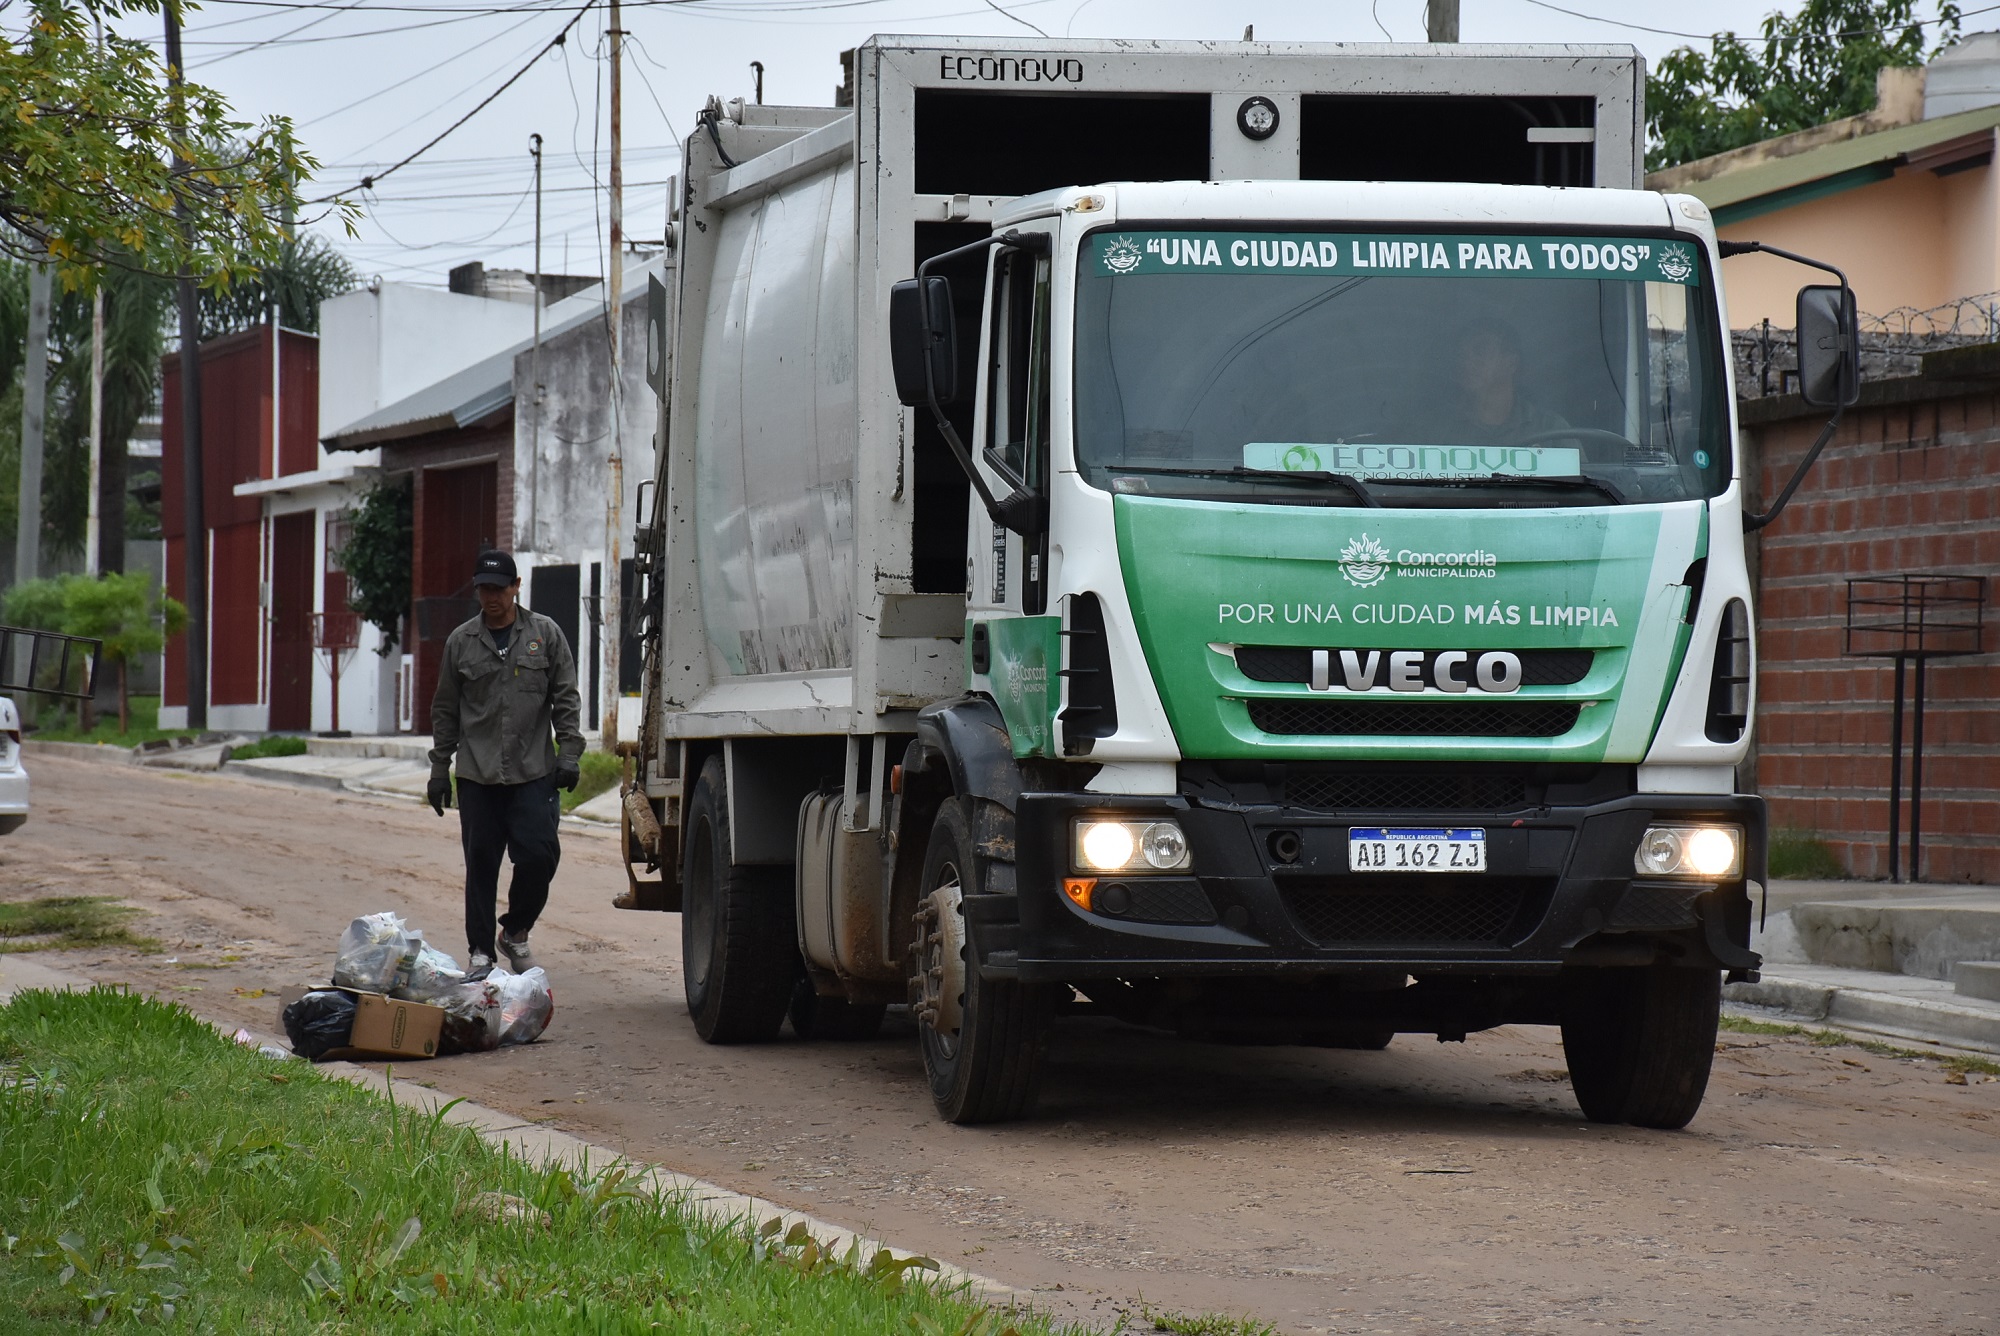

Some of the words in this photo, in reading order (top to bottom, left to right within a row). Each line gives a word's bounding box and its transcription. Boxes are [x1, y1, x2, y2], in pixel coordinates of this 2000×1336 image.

[1230, 240, 1338, 268] CIUDAD
[1352, 241, 1450, 269] LIMPIA
[1457, 243, 1533, 270] PARA
[1397, 549, 1497, 567] Concordia
[1397, 568, 1496, 578] MUNICIPALIDAD
[1218, 603, 1274, 624] POR
[1284, 604, 1342, 624] UNA
[1352, 604, 1455, 625] CIUDAD
[1464, 600, 1521, 626] MÁS
[1530, 606, 1619, 628] LIMPIA
[1311, 650, 1523, 693] IVECO
[1357, 843, 1386, 867] AD
[1395, 843, 1440, 867] 162
[1449, 843, 1479, 867] ZJ
